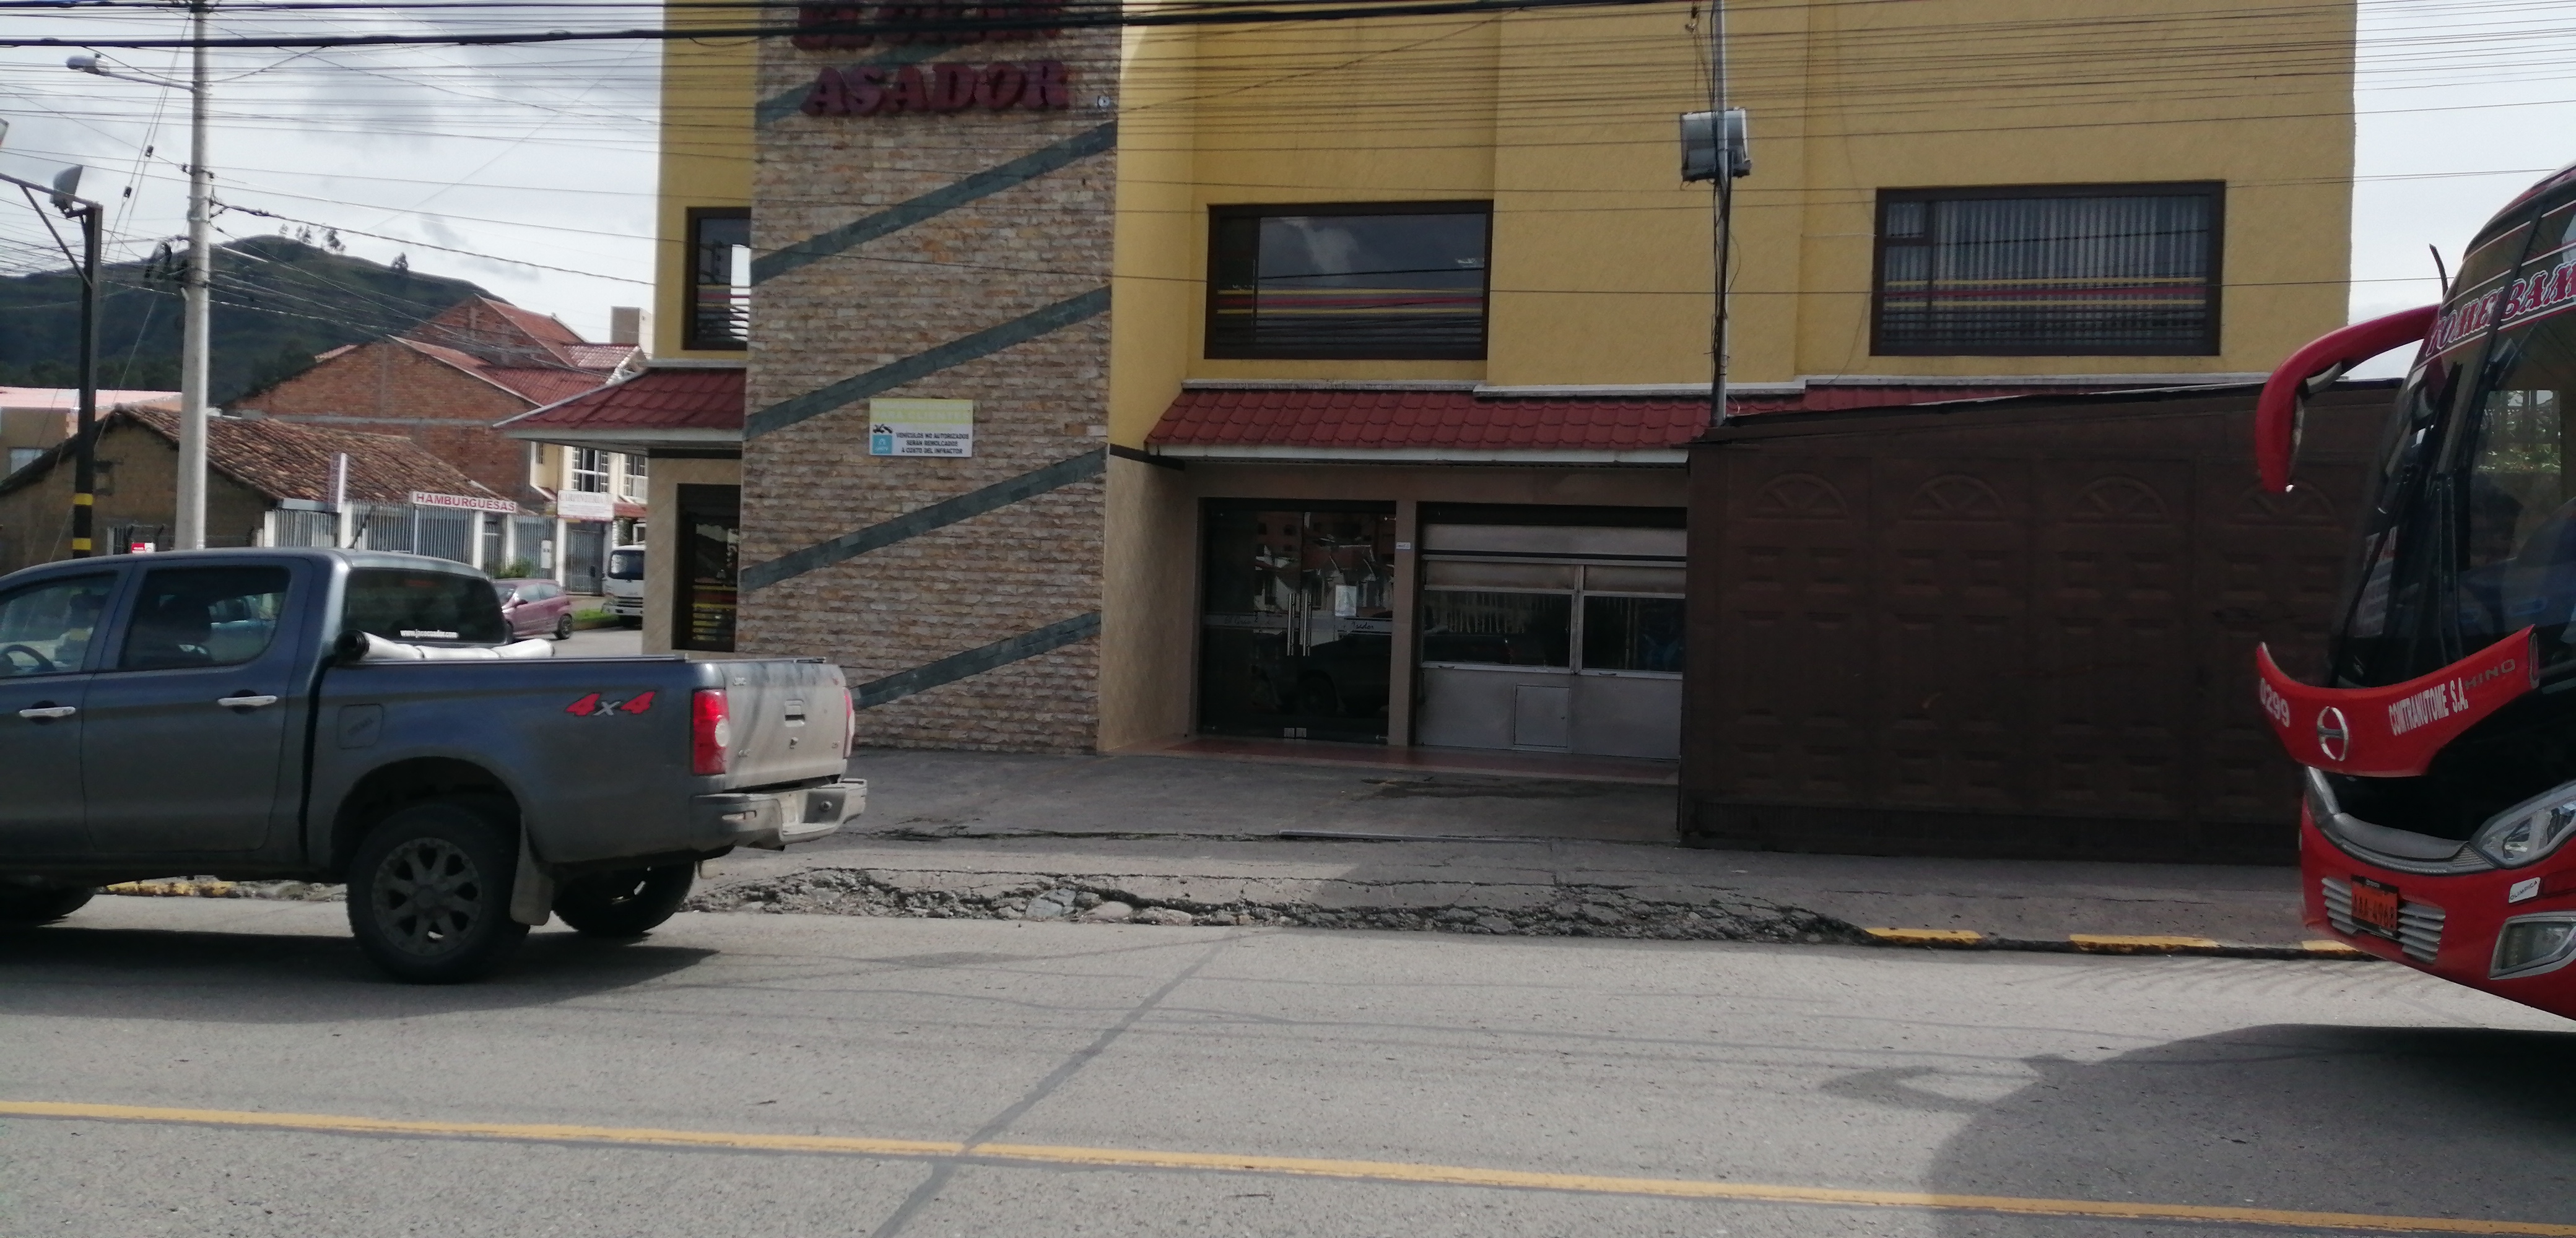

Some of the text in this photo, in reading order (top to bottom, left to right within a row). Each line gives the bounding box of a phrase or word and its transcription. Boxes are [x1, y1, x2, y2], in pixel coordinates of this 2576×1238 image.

[801, 61, 1069, 116] ASADOR
[416, 493, 515, 512] HAMBURGUESAS
[2465, 658, 2516, 690] HINO
[2260, 677, 2290, 727] 0299
[2450, 677, 2469, 713] S.A.
